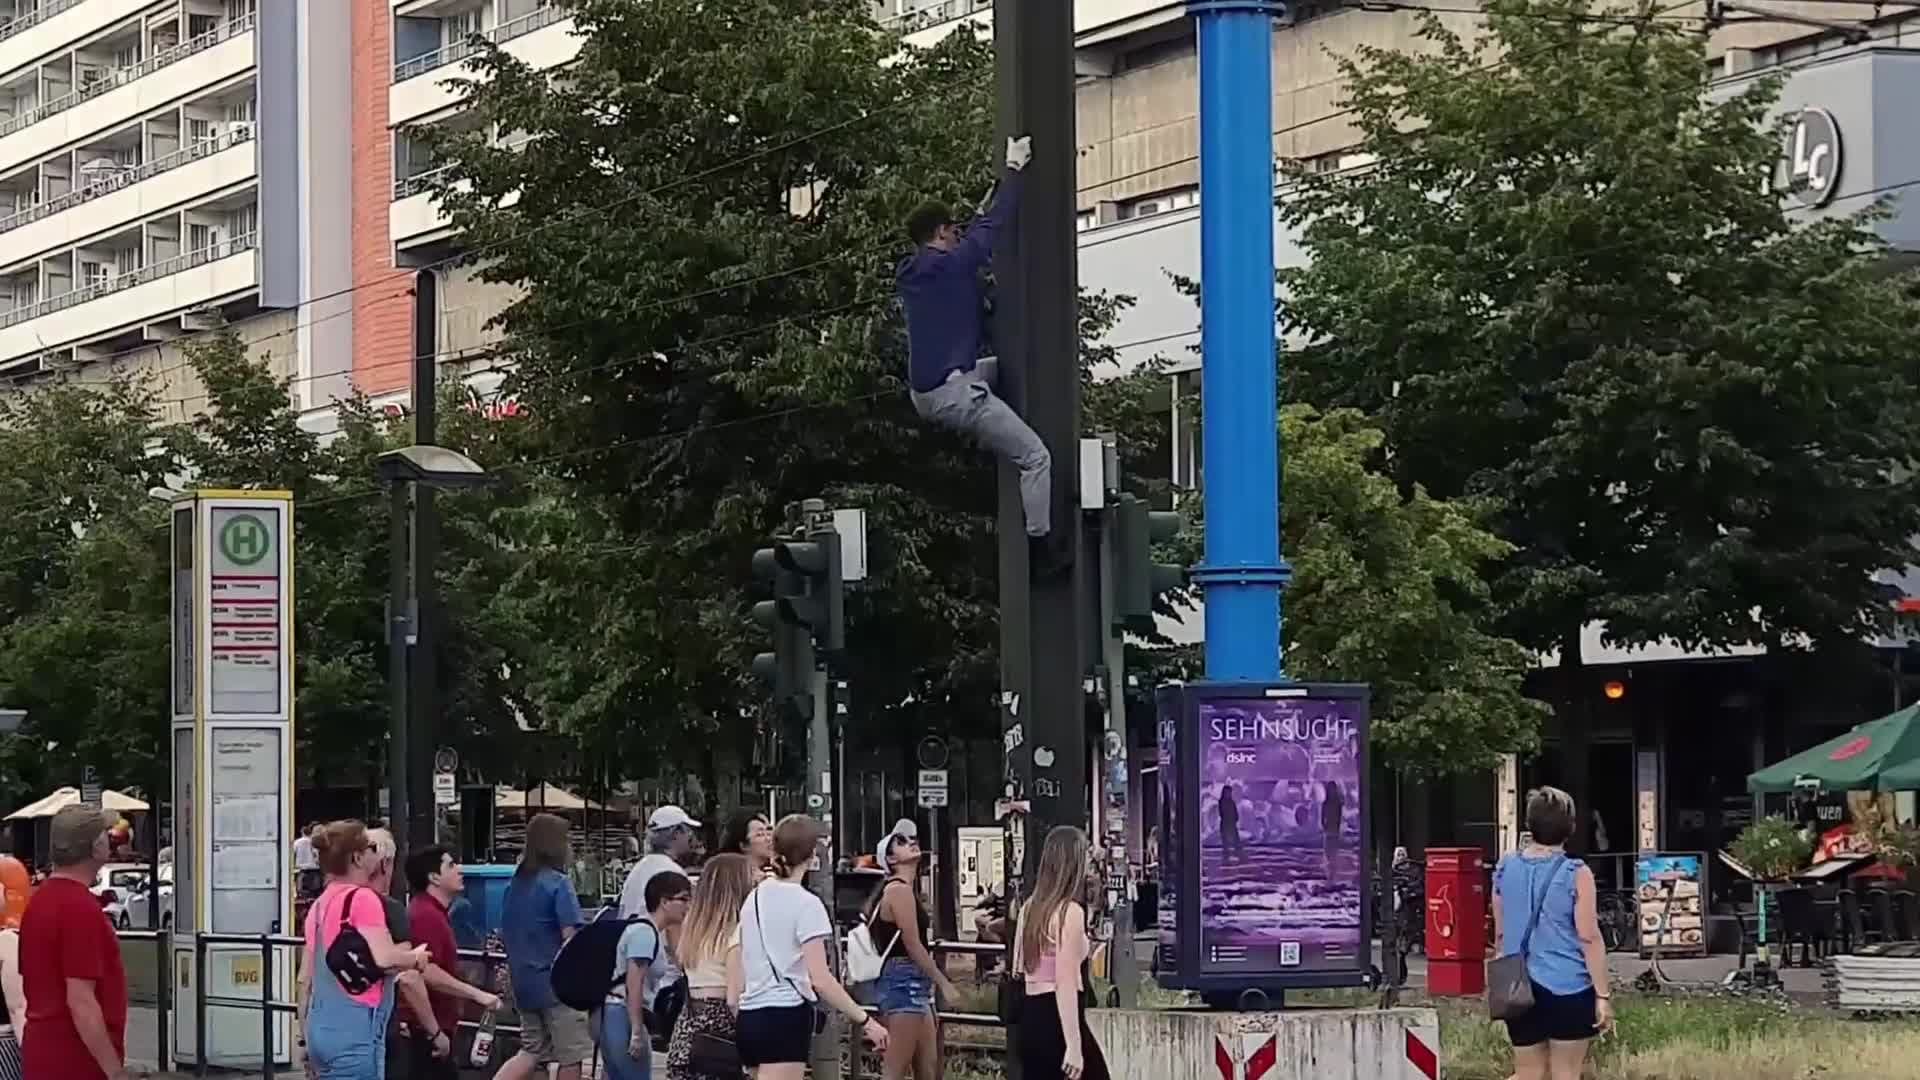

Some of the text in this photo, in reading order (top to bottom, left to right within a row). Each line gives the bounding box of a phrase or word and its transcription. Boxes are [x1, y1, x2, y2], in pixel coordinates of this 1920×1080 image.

[232, 526, 257, 554] H
[1210, 718, 1352, 741] SEHNSUCHT
[234, 970, 257, 983] BVG
